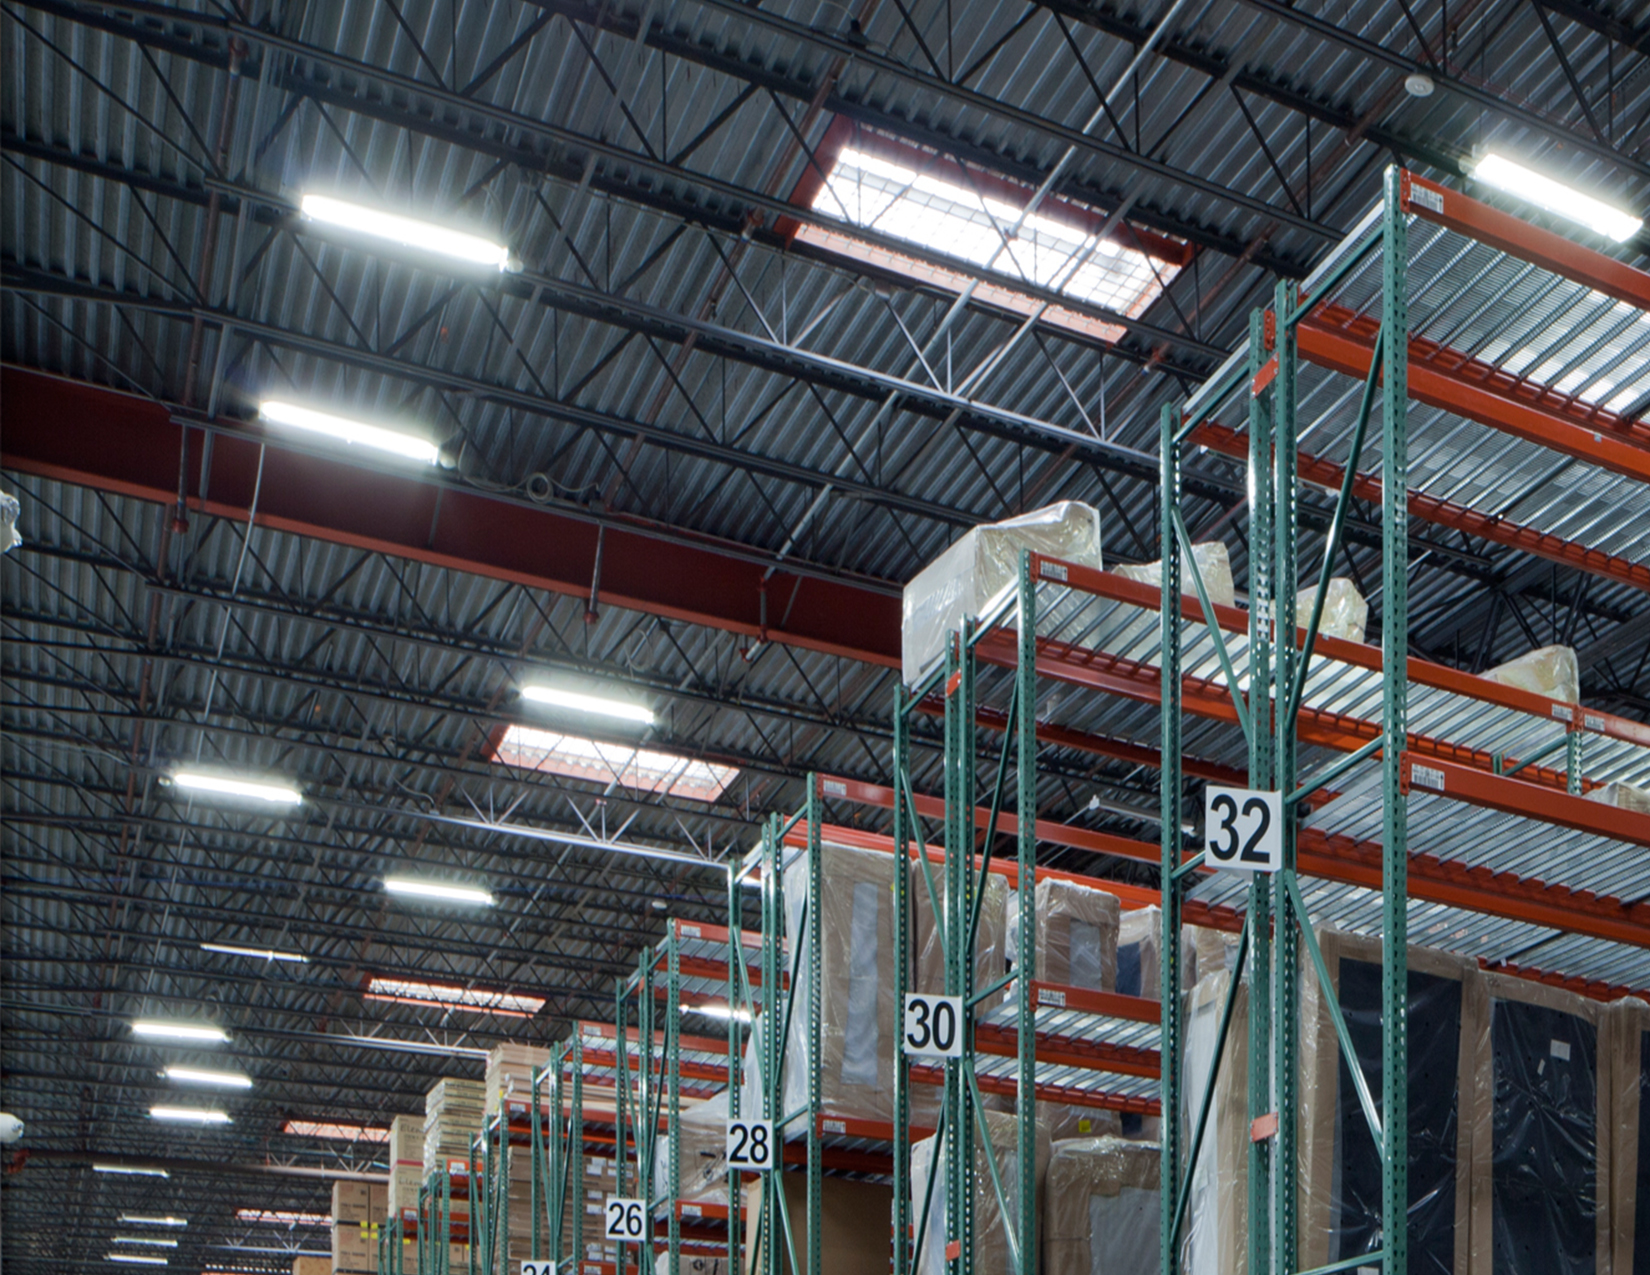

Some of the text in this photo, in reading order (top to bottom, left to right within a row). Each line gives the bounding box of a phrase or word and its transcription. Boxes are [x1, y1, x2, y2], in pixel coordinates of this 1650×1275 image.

[1208, 794, 1271, 865] 32
[906, 999, 955, 1051] 30
[729, 1123, 769, 1164] 28
[608, 1202, 643, 1237] 26
